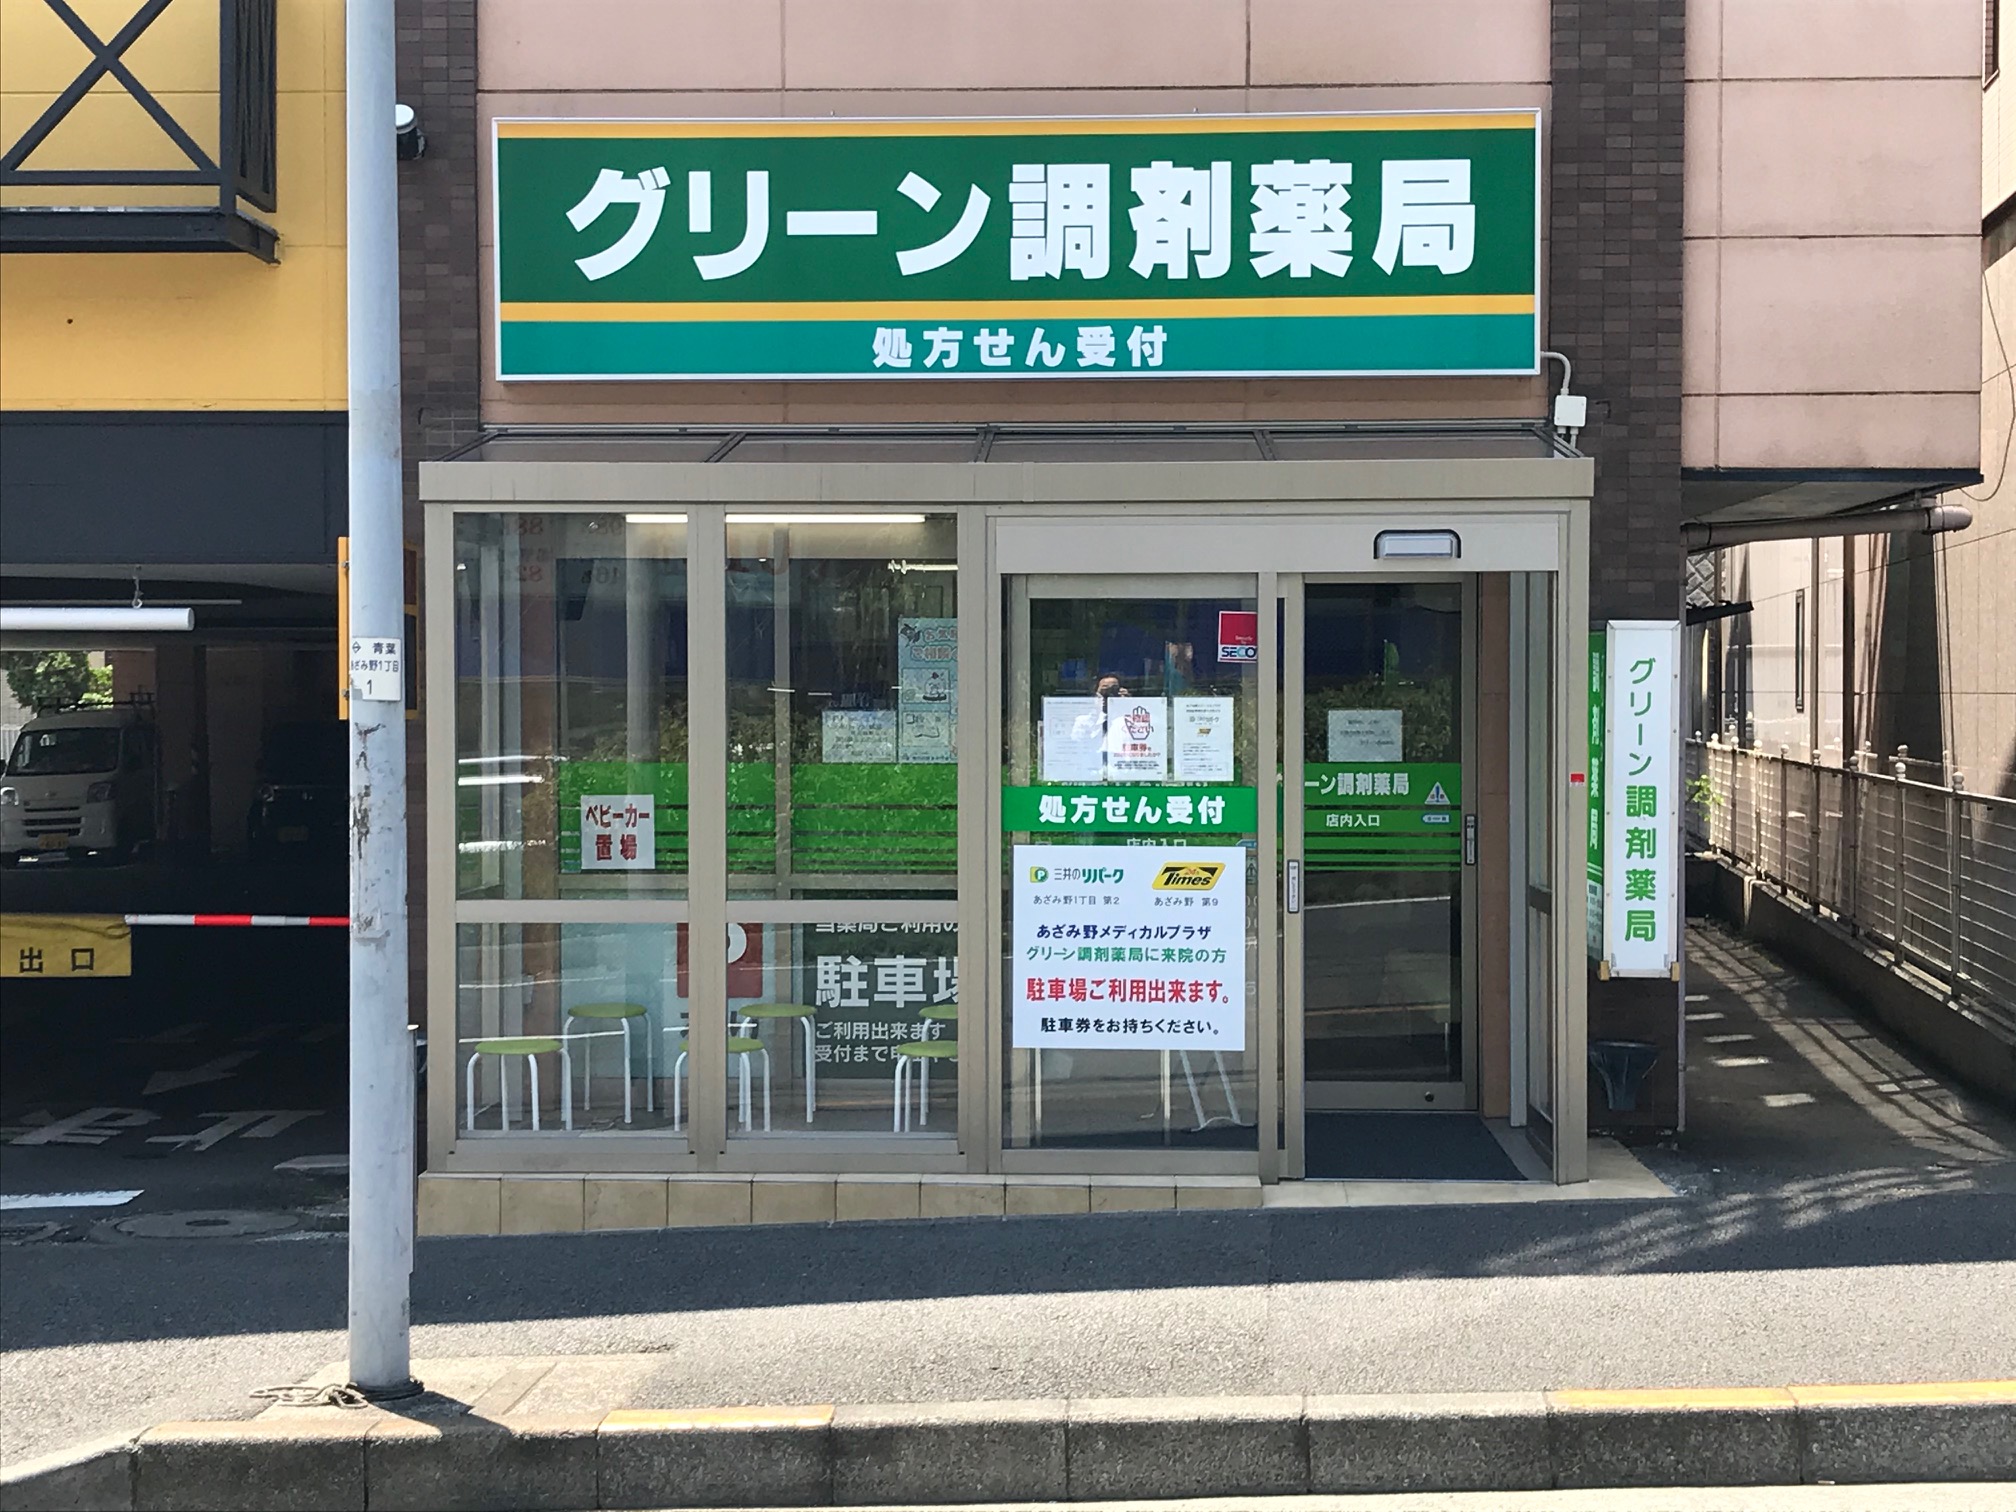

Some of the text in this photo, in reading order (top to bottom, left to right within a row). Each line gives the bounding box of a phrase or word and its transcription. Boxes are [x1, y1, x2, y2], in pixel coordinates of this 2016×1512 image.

[565, 157, 1475, 281] グリーン調剤薬局
[872, 325, 1168, 369] 処方せん受付
[372, 642, 396, 655] 青葉
[1221, 646, 1257, 658] SECO
[366, 679, 373, 695] 1
[1624, 657, 1657, 942] グリーン調剤薬局
[585, 803, 650, 829] ベビーカー
[1038, 794, 1227, 825] 処方せん受付
[1325, 814, 1381, 828] 店内入口
[595, 833, 638, 861] 置場
[1054, 866, 1124, 884] 三井のリパーク
[1163, 871, 1213, 886] Times
[1033, 894, 1121, 906] あざみ野1丁目 第2
[1154, 896, 1219, 907] あざみ野 第9
[1036, 923, 1212, 940] あざみ野メディカルプラザ
[19, 946, 95, 973] 出口
[1026, 945, 1228, 964] グリーン調剤薬局に来院の方
[1026, 977, 1229, 1004] 駐車場ご利用出来ます。
[816, 1021, 946, 1040] ご利用出来ます
[1040, 1016, 1220, 1036] 駐車券をお持ちください。
